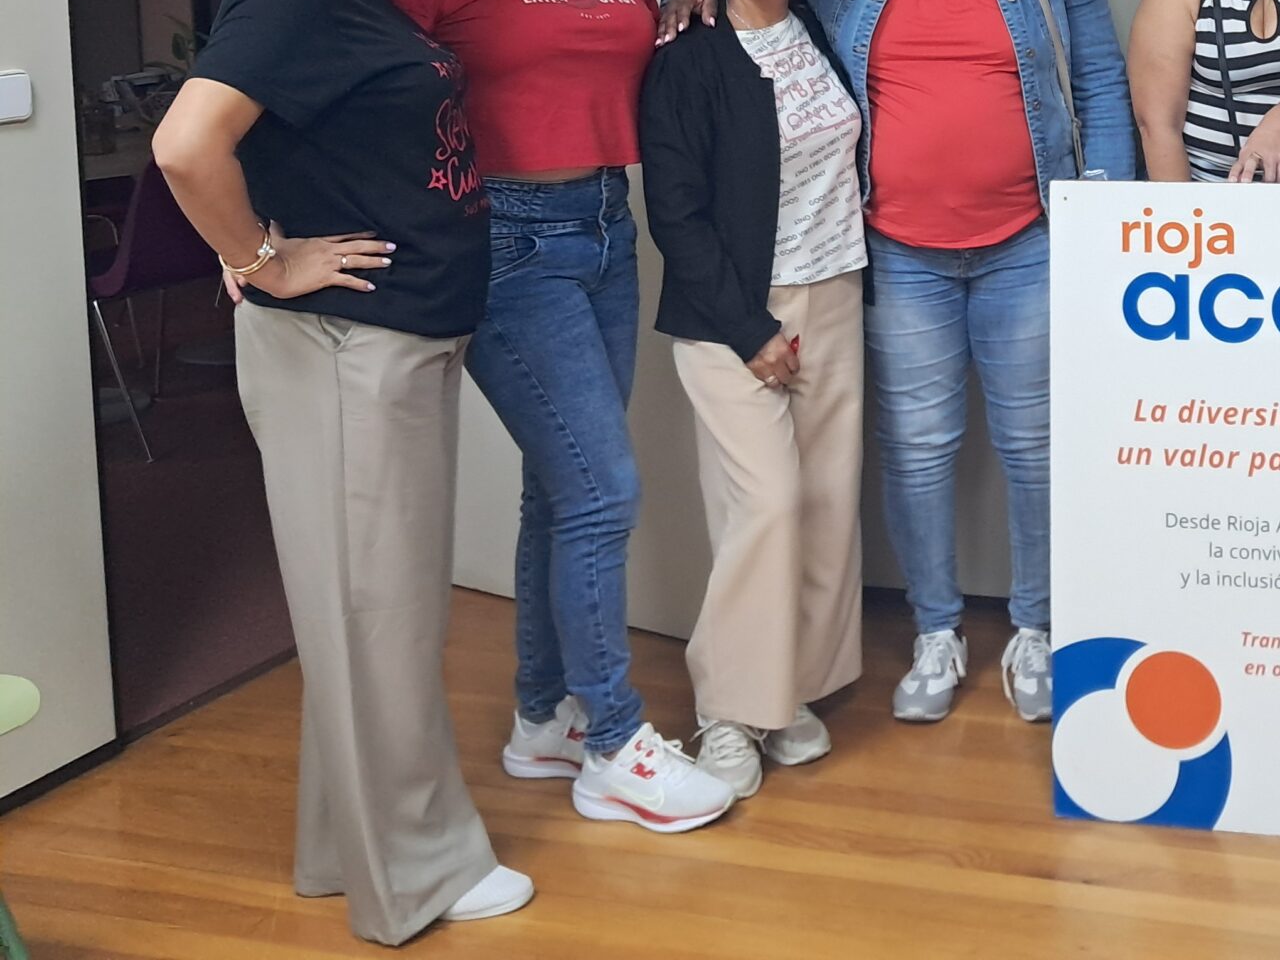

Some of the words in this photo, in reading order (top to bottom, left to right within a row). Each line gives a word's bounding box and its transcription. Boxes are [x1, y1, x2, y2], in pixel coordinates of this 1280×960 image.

[1122, 207, 1236, 269] rioja
[1134, 399, 1167, 423] La
[1118, 447, 1152, 466] un
[1163, 442, 1241, 469] valor
[1165, 512, 1221, 531] Desde
[1227, 514, 1271, 538] Rioja
[1208, 541, 1224, 558] la
[1180, 572, 1190, 589] y
[1196, 569, 1211, 586] la
[1245, 663, 1266, 676] en
